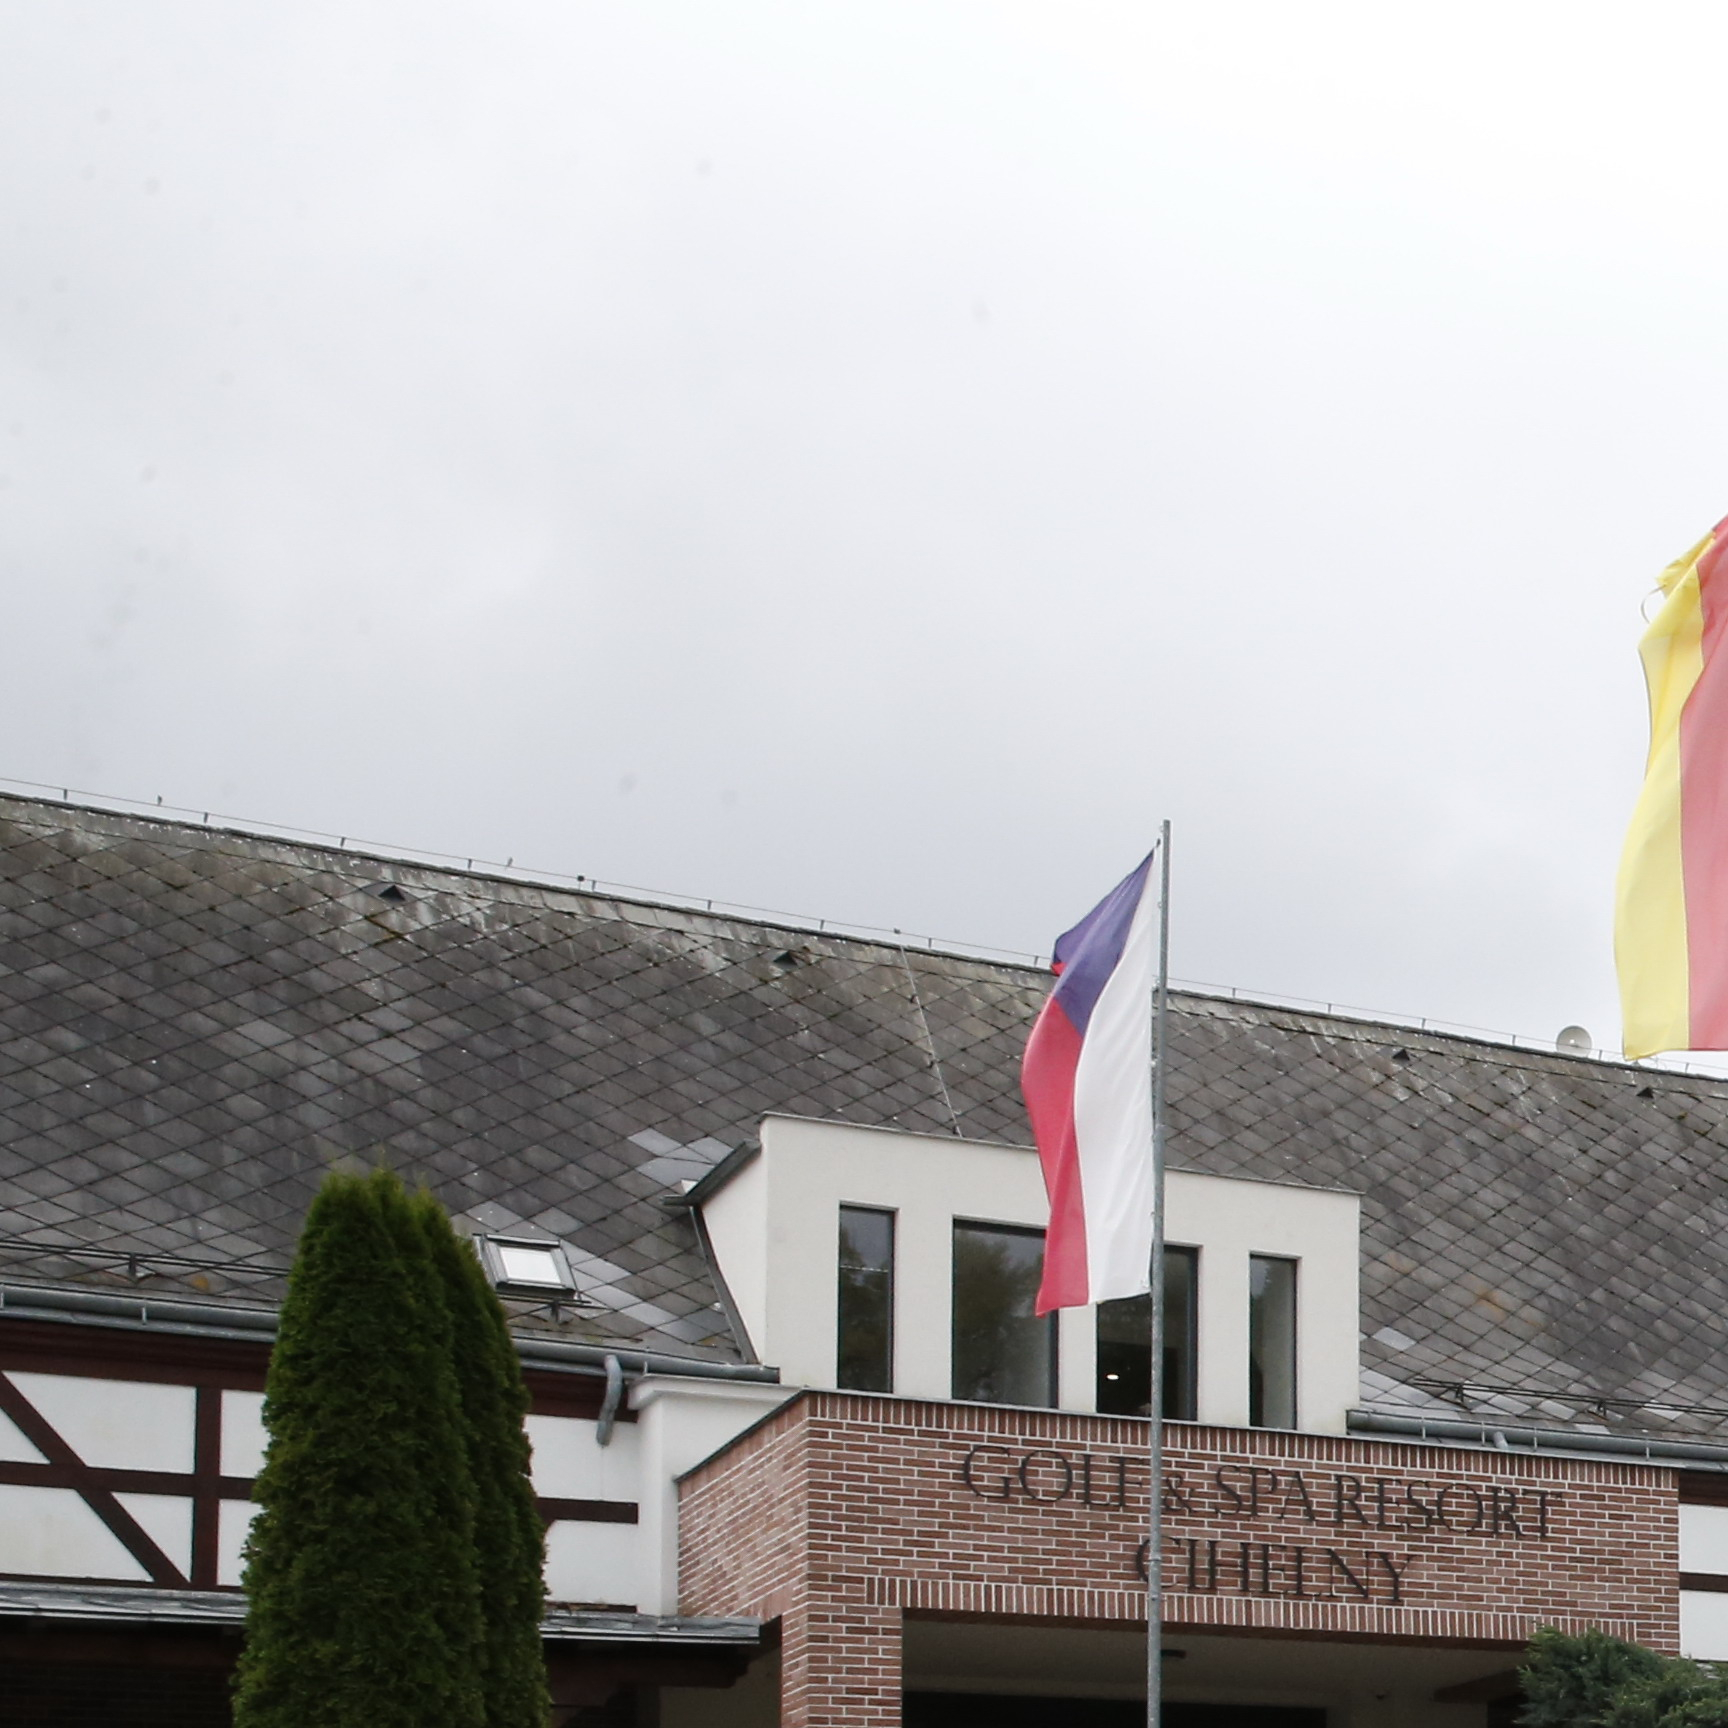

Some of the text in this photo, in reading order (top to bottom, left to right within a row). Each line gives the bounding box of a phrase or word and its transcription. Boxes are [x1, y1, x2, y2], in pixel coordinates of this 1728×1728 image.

[962, 1445, 1564, 1540] GOLF & SPA RESORT
[1135, 1535, 1416, 1605] CIHELNY
